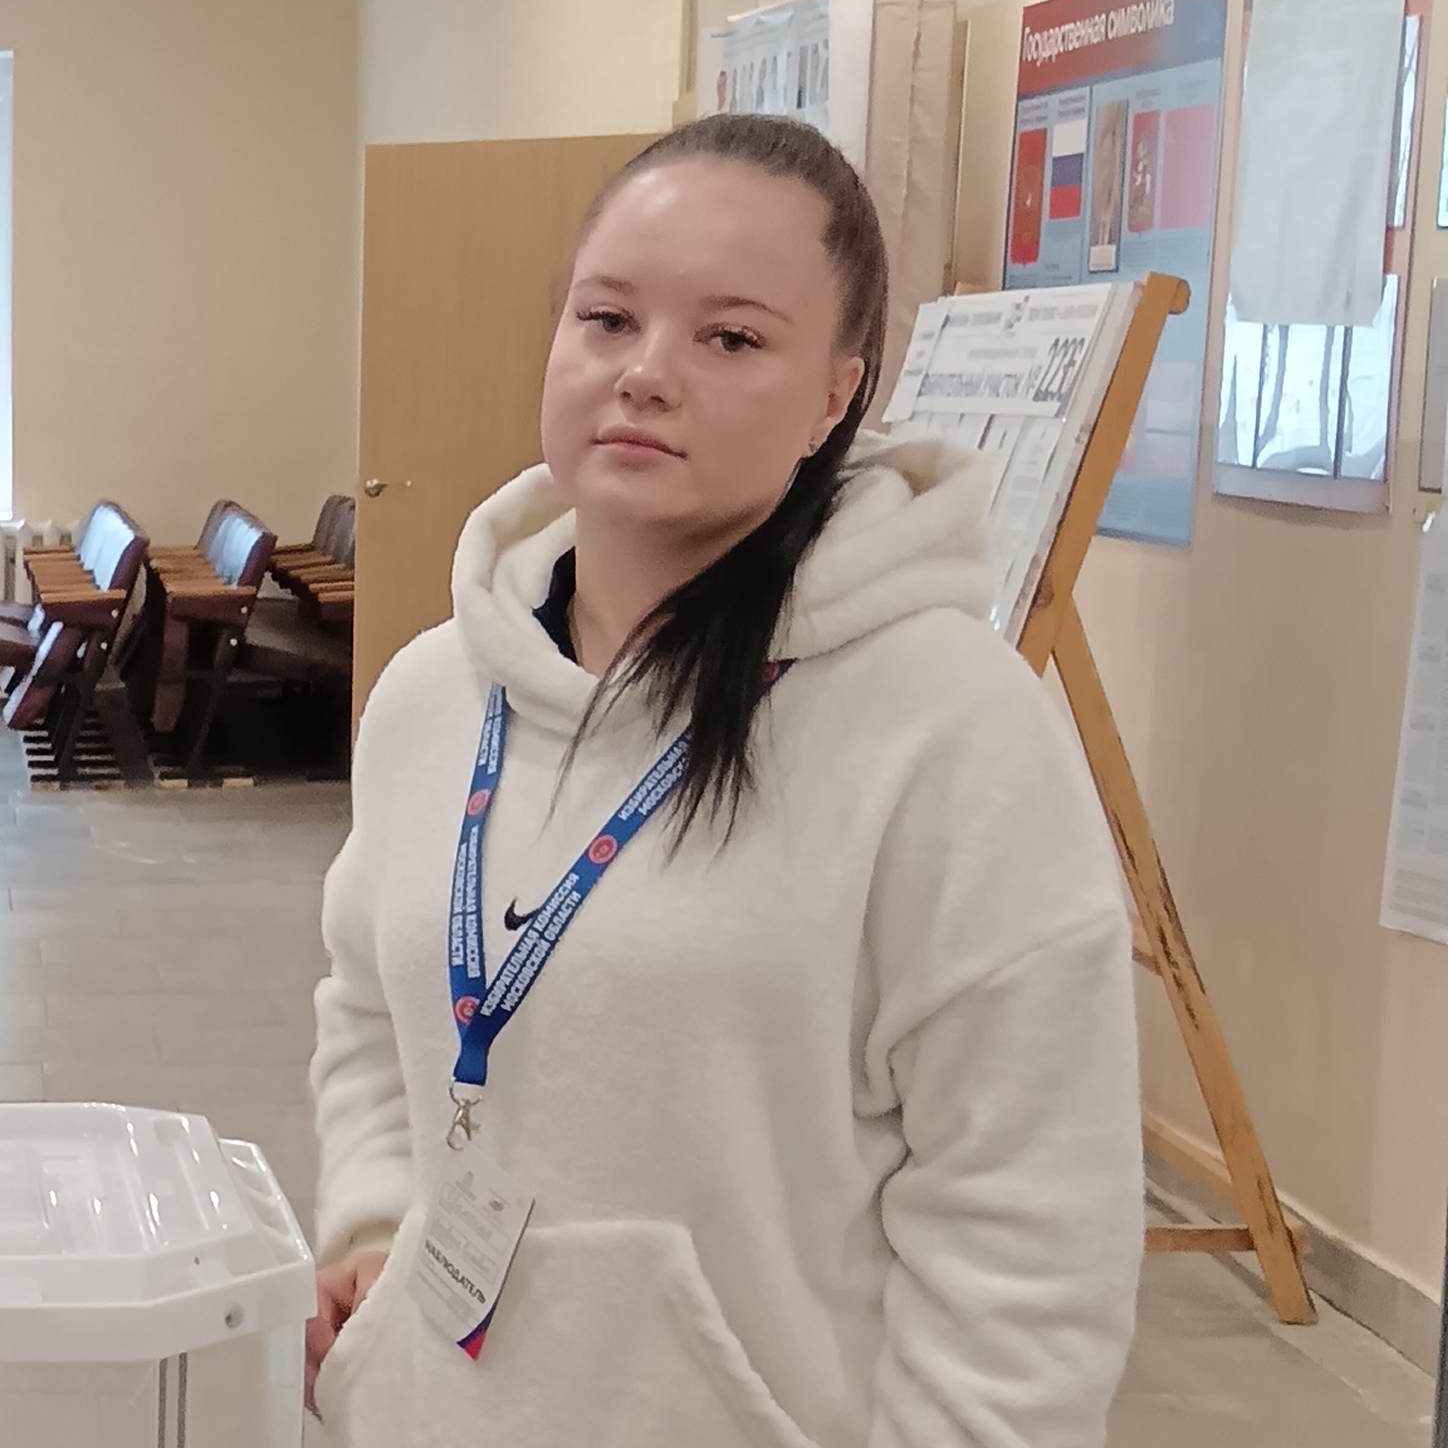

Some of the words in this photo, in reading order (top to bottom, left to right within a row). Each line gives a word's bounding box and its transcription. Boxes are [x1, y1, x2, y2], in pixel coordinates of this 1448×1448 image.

[1021, 13, 1106, 67] Государственная
[618, 740, 689, 821] ИЗБИРАТЕЛЬНАЯ
[637, 756, 690, 816] МОСКОВСК
[480, 929, 540, 1016] ИЗБИРАТЕЛЬНАЯ
[532, 872, 579, 932] КОМИССИЯ
[500, 939, 552, 1012] МОСКОВСКОЙ
[544, 890, 582, 942] ОБЛАСТИ
